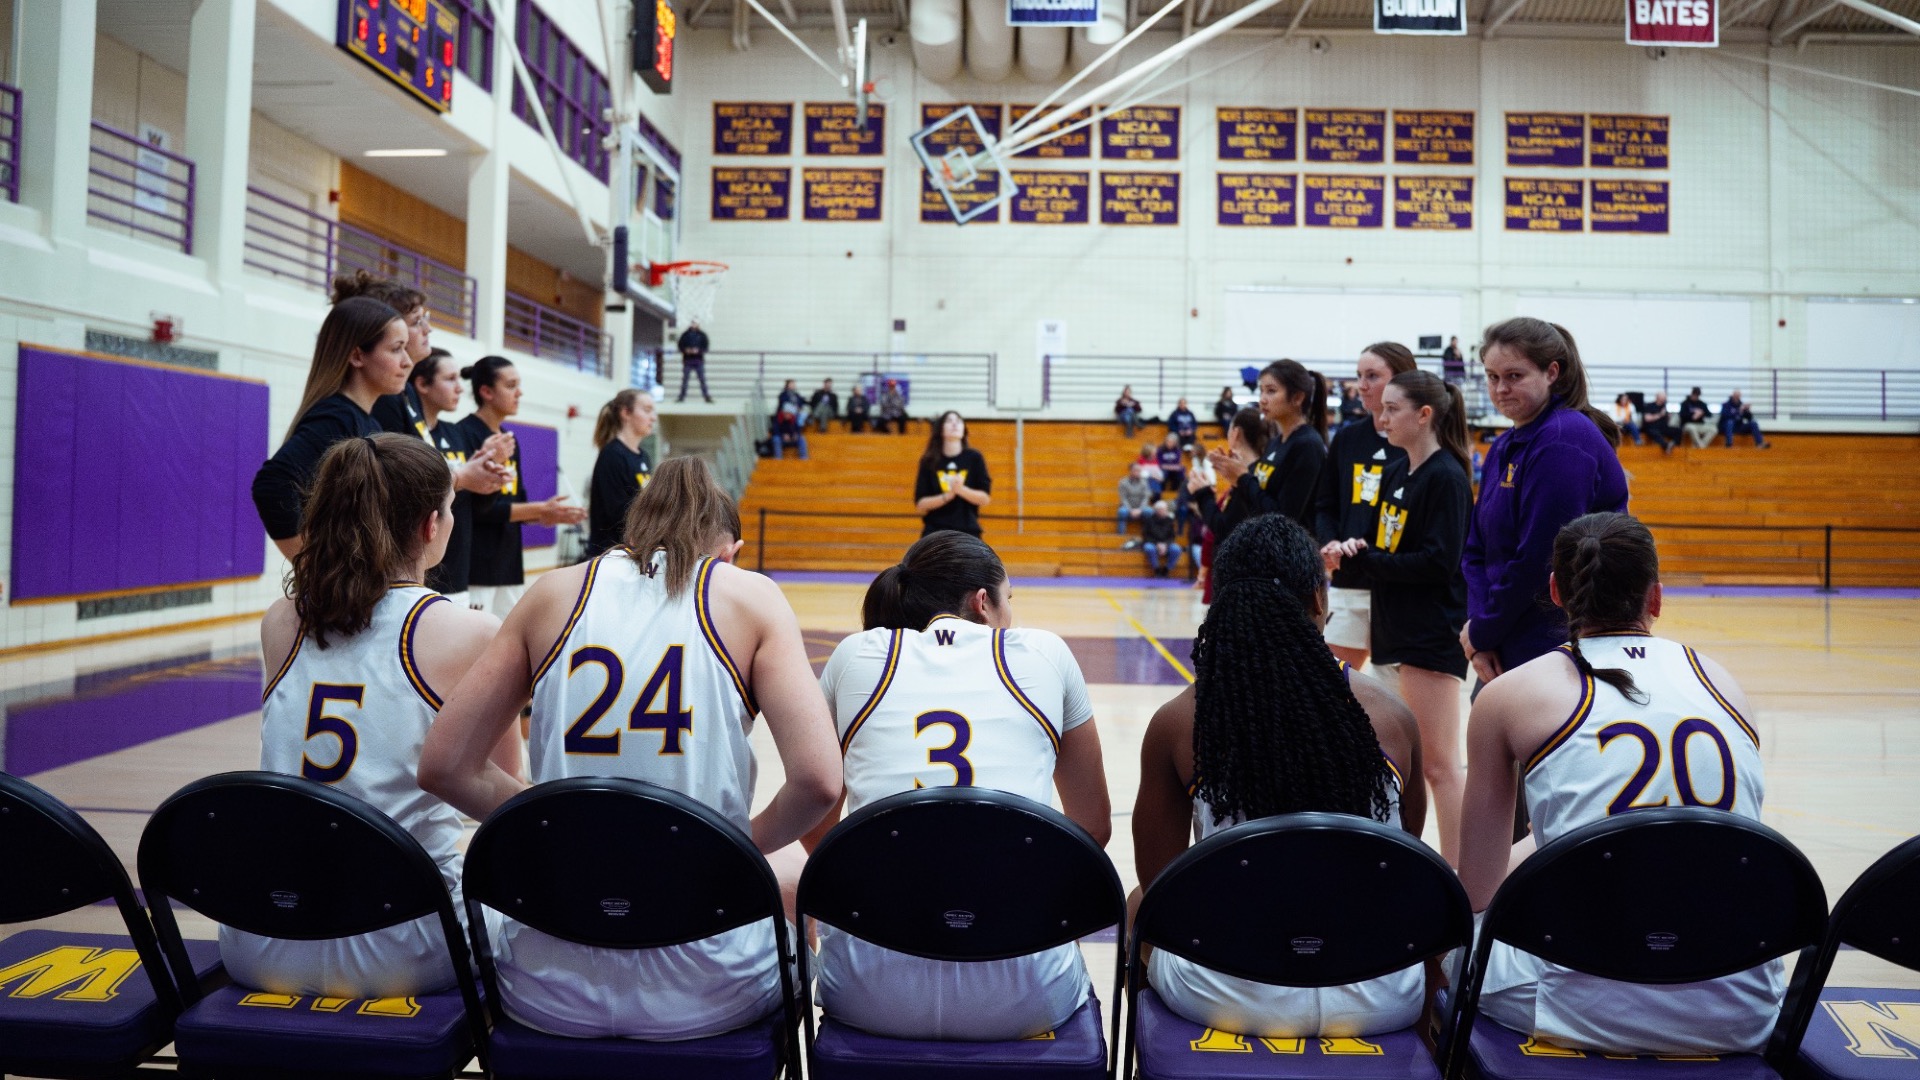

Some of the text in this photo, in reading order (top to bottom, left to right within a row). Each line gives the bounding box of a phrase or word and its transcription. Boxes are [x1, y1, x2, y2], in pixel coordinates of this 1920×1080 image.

[1635, 0, 1709, 26] BATES
[377, 32, 387, 54] 5
[425, 66, 434, 88] 5
[731, 118, 774, 129] NCAA
[1117, 121, 1160, 133] NCAA
[1235, 123, 1278, 135] NCAA
[1322, 125, 1365, 137] NCAA
[1410, 126, 1455, 138] NCAA
[1529, 127, 1561, 136] NCAA
[1604, 131, 1652, 143] NCAA
[1310, 138, 1379, 151] FINAL FOUR
[1626, 144, 1669, 157] SIXTEEN
[729, 182, 773, 194] NCAA
[810, 183, 875, 195] NESCAC
[1026, 186, 1071, 199] NCAA
[1116, 187, 1160, 200] NCAA
[1235, 188, 1278, 201] NCAA
[810, 196, 875, 208] CHAMPIONS
[1322, 190, 1366, 202] NCAA
[1410, 189, 1455, 202] NCAA
[1522, 194, 1566, 206] NCAA
[1612, 193, 1646, 203] NCAA
[1019, 200, 1047, 212] ELITE
[1105, 200, 1173, 213] FINAL FOUR
[1222, 201, 1291, 214] ELITE EIGHT
[1314, 203, 1342, 215] ELITE
[1394, 201, 1472, 214] SWEET SIXTEEN
[1505, 206, 1538, 219] SWEET
[1541, 207, 1583, 220] SIXTEEN
[934, 629, 956, 646] W
[1622, 646, 1647, 660] W
[563, 643, 694, 756] 24
[300, 681, 366, 785] 5
[913, 708, 976, 790] 3
[1596, 716, 1737, 817] 20
